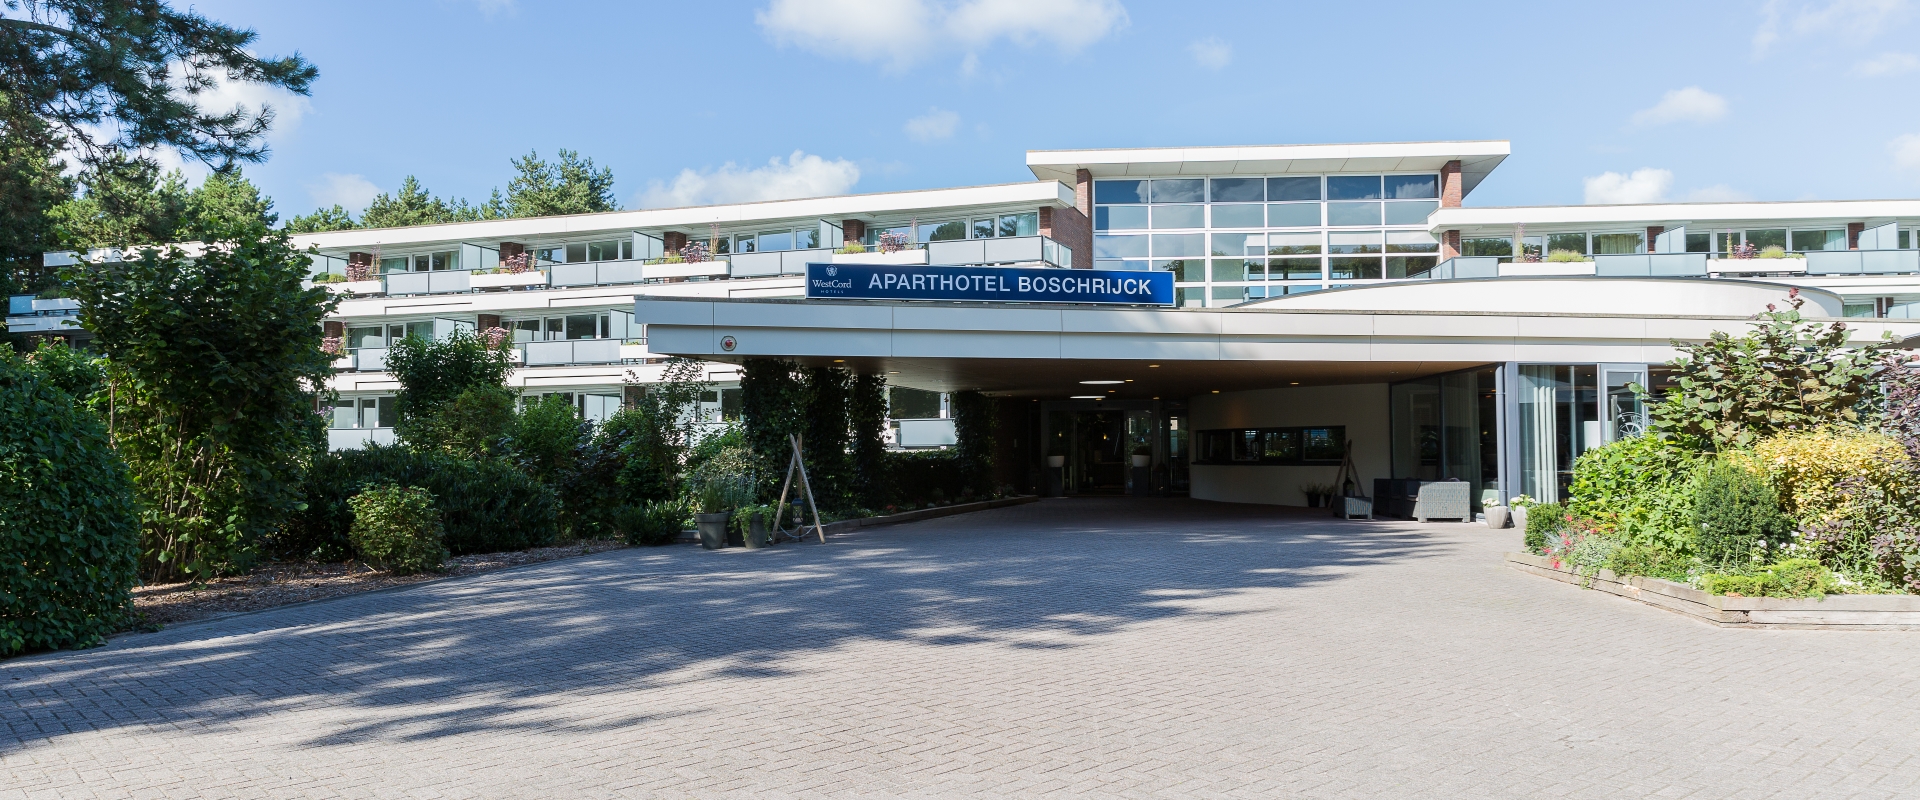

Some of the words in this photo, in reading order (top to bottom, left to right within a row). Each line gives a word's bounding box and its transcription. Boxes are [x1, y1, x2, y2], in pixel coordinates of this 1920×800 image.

[812, 278, 852, 289] WestCord
[868, 272, 1011, 292] APARTHOTEL
[1018, 276, 1152, 295] BOSCHRIJCK
